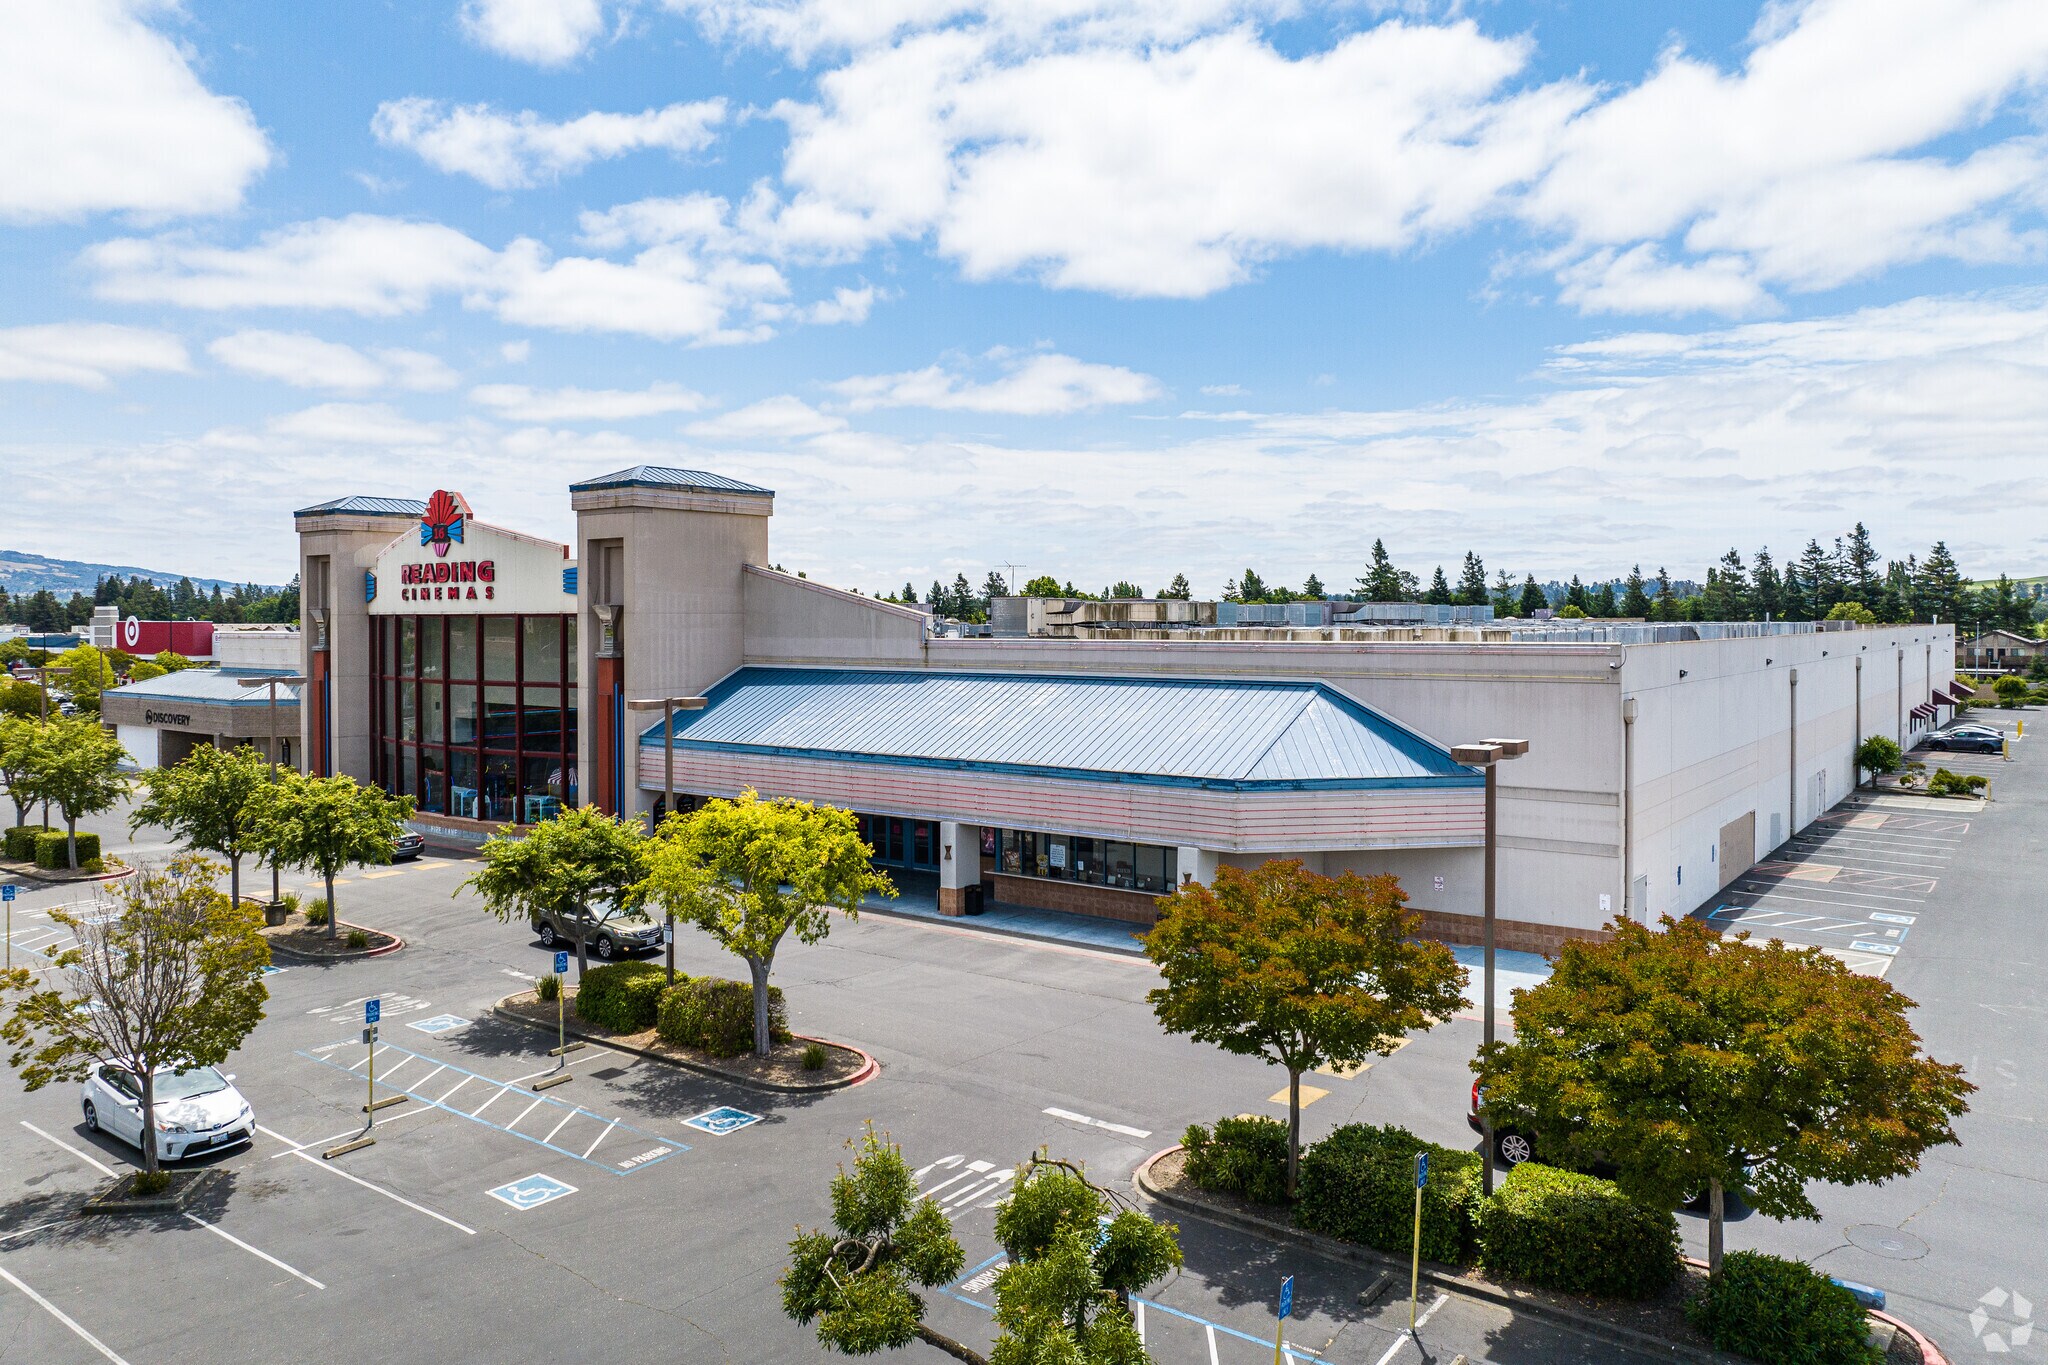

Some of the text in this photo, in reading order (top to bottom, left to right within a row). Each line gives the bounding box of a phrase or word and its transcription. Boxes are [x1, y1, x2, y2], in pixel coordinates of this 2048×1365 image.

[433, 527, 445, 539] 16
[401, 561, 495, 584] READING
[401, 586, 495, 601] CINEMAS
[153, 712, 191, 726] DISCOVERY
